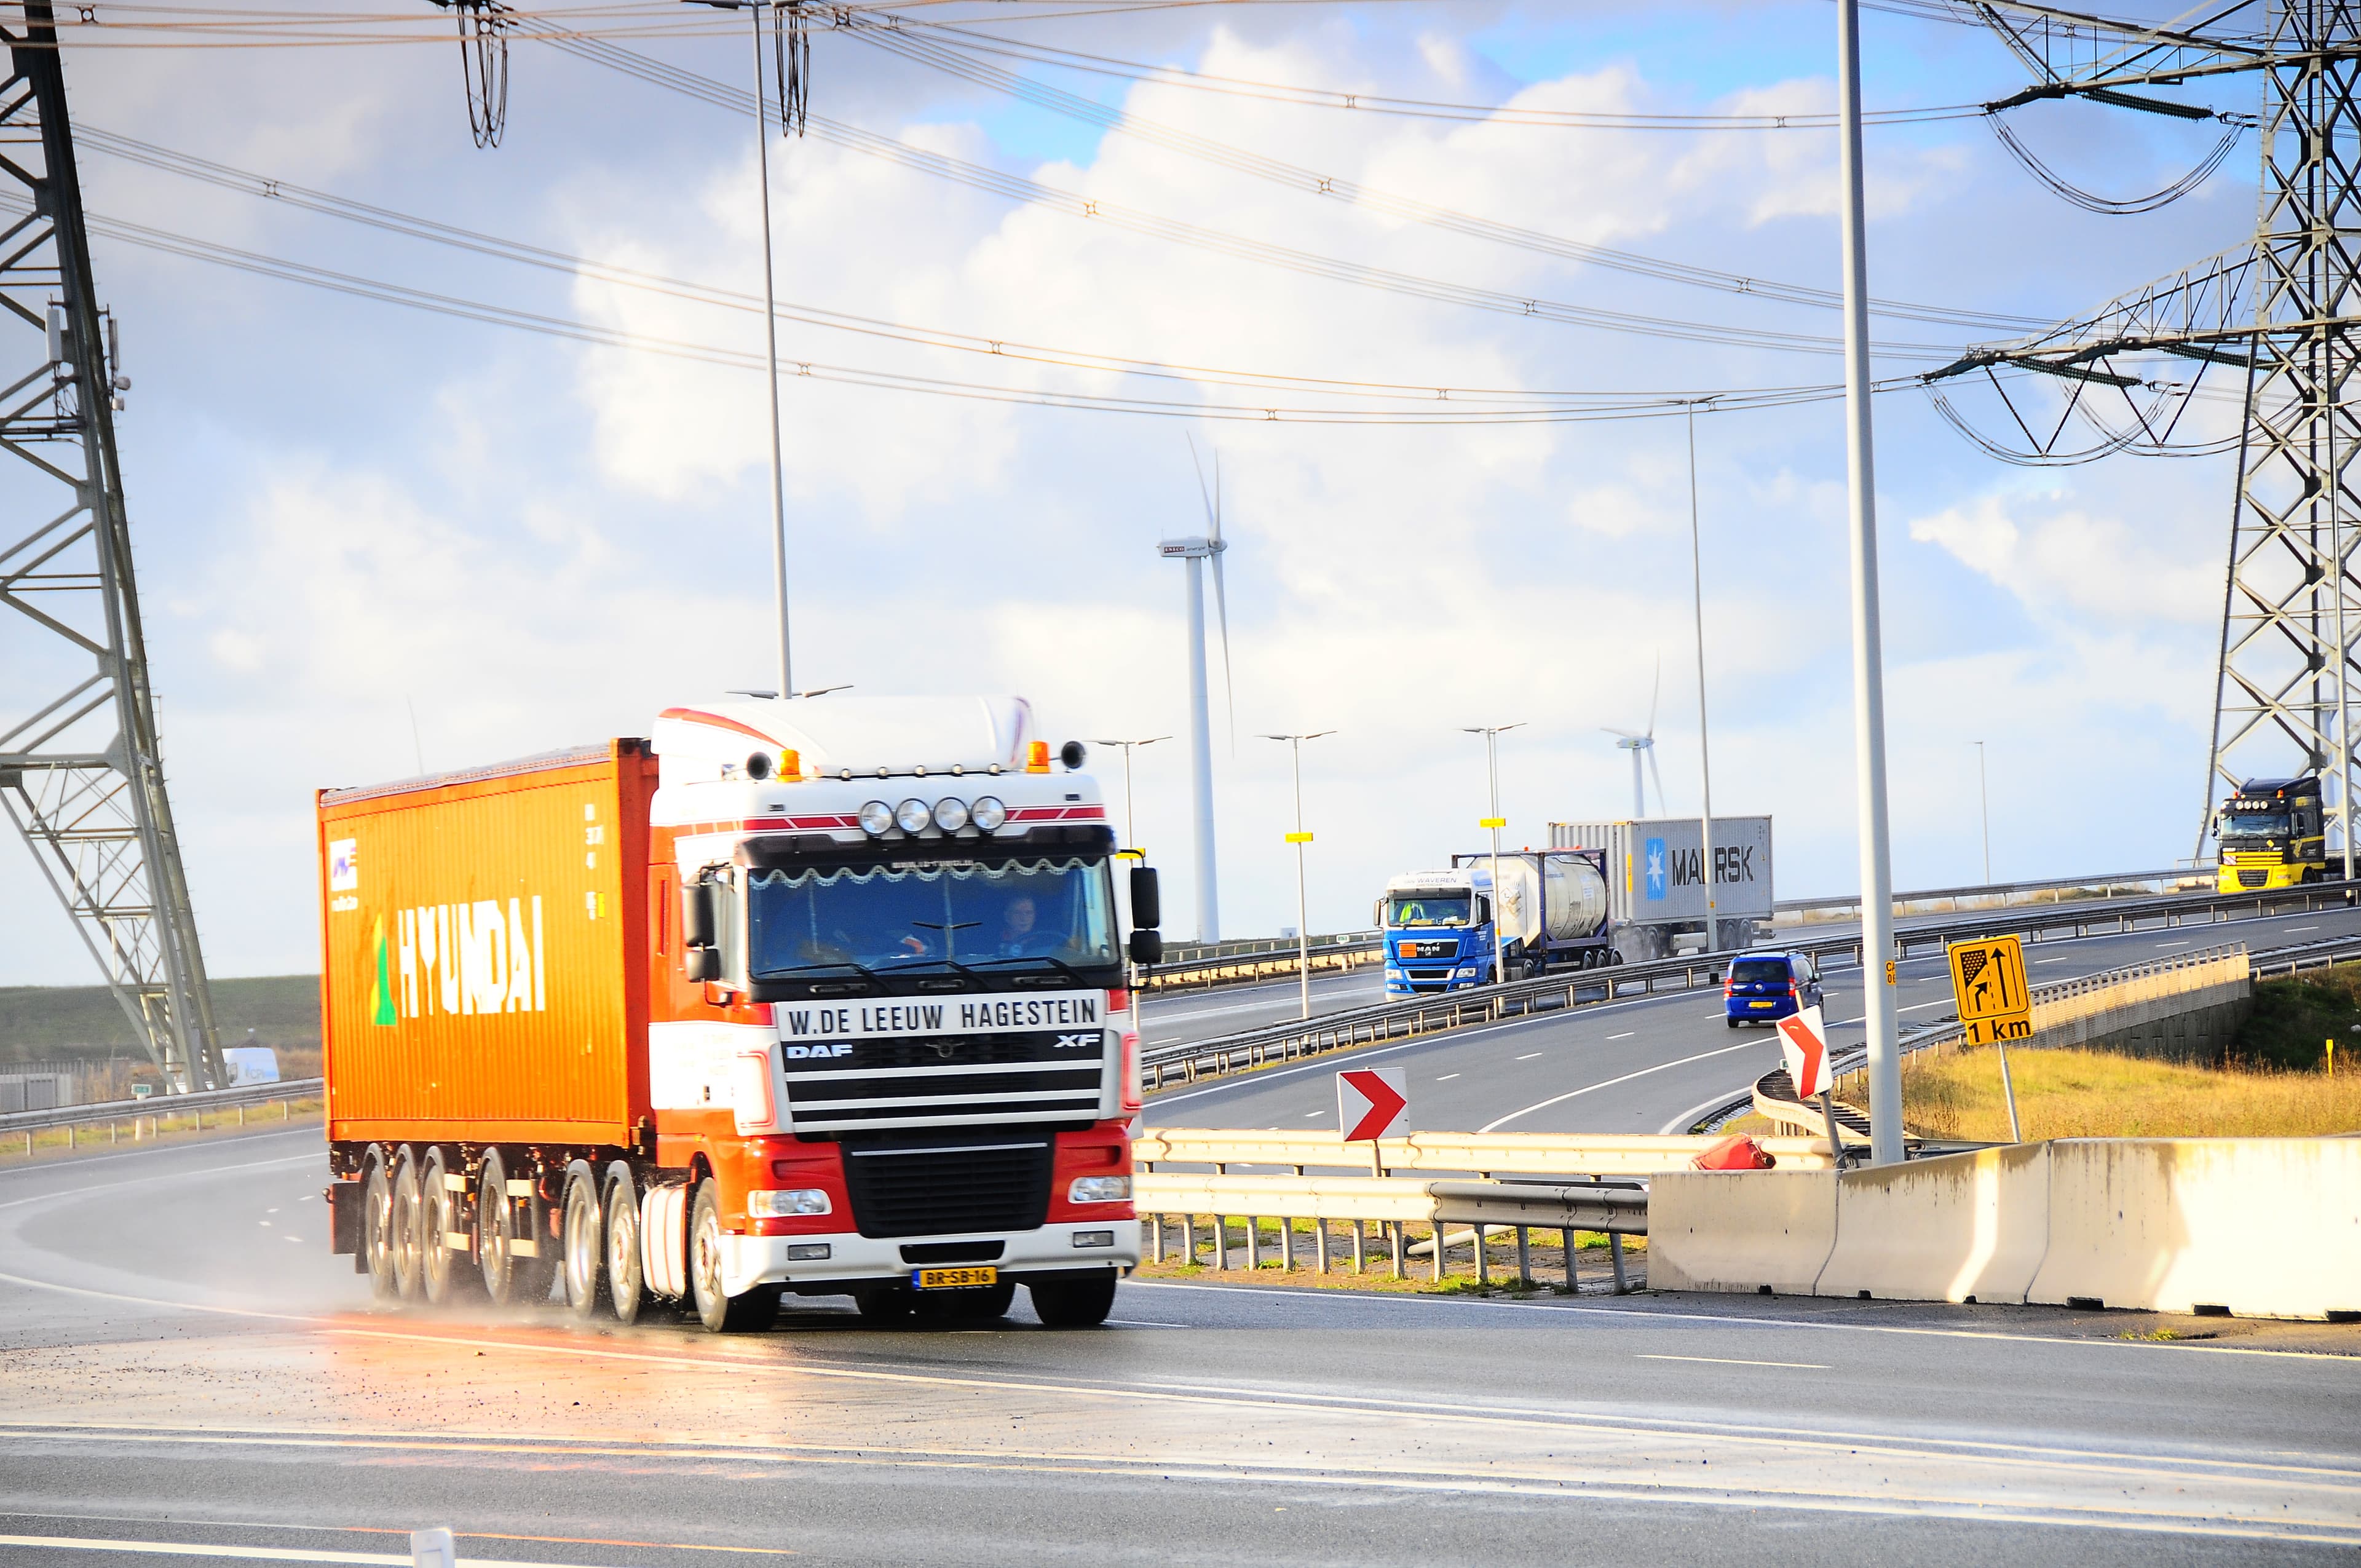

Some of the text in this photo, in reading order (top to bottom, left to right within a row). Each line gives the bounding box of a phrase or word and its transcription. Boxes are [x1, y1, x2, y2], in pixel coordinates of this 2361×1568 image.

[1672, 845, 1754, 886] MARSK
[398, 895, 545, 1018] HYUNDAI
[788, 998, 1096, 1035] W.DE LEEUW HAGESTEIN
[1969, 1019, 2031, 1043] 1 km
[786, 1034, 1101, 1059] DAF XF
[926, 1270, 990, 1285] BR-SB-16
